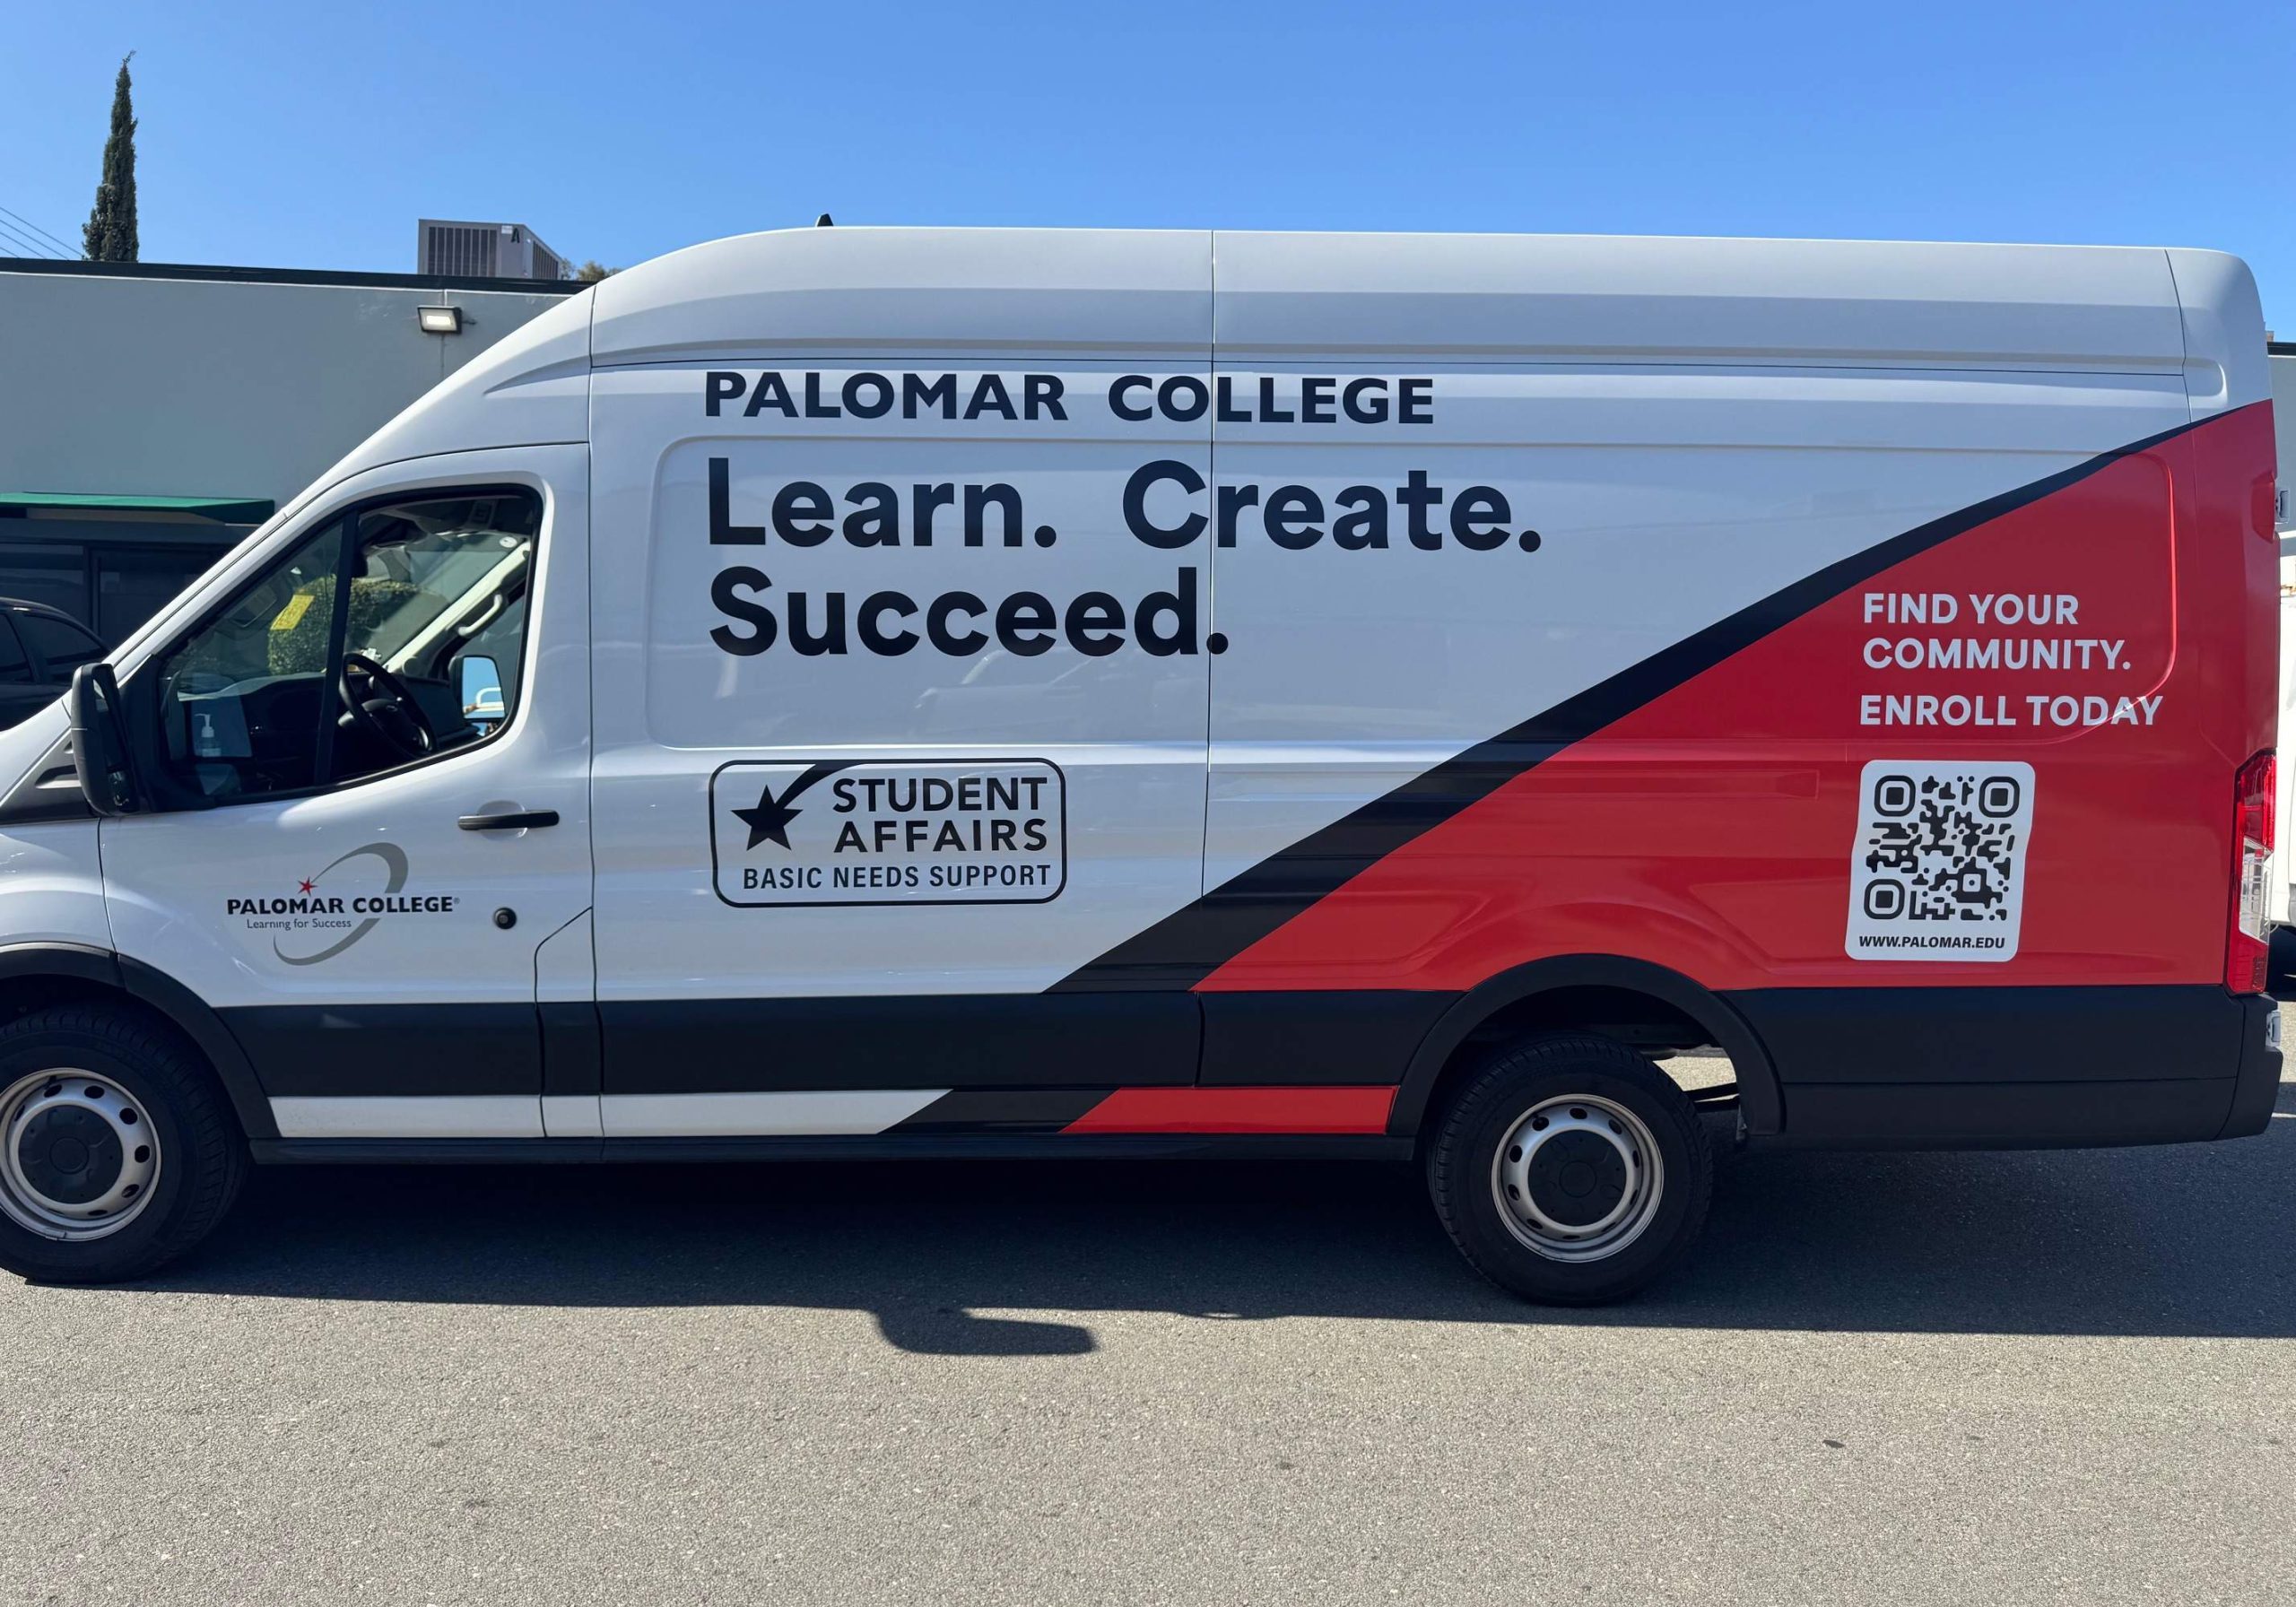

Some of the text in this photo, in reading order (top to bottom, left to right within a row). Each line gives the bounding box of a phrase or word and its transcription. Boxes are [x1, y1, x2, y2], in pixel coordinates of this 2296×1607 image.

[705, 371, 1434, 425] PALOMAR COLLEGE
[708, 456, 1542, 553] Learn. Create.
[709, 566, 1229, 657] Succeed.
[1863, 593, 2079, 625] FIND YOUR
[1863, 637, 2132, 670] COMMUNITY.
[1859, 694, 2164, 726] ENROLL TODAY
[832, 777, 1048, 813] STUDENT
[833, 818, 1048, 854] AFFAIRS
[743, 864, 1051, 890] BASIC NEEDS SUPPORT
[227, 898, 345, 916] PALOMAR
[247, 917, 352, 931] Learning for Success
[1858, 935, 2005, 949] WWW.PALOMAR.EDU
